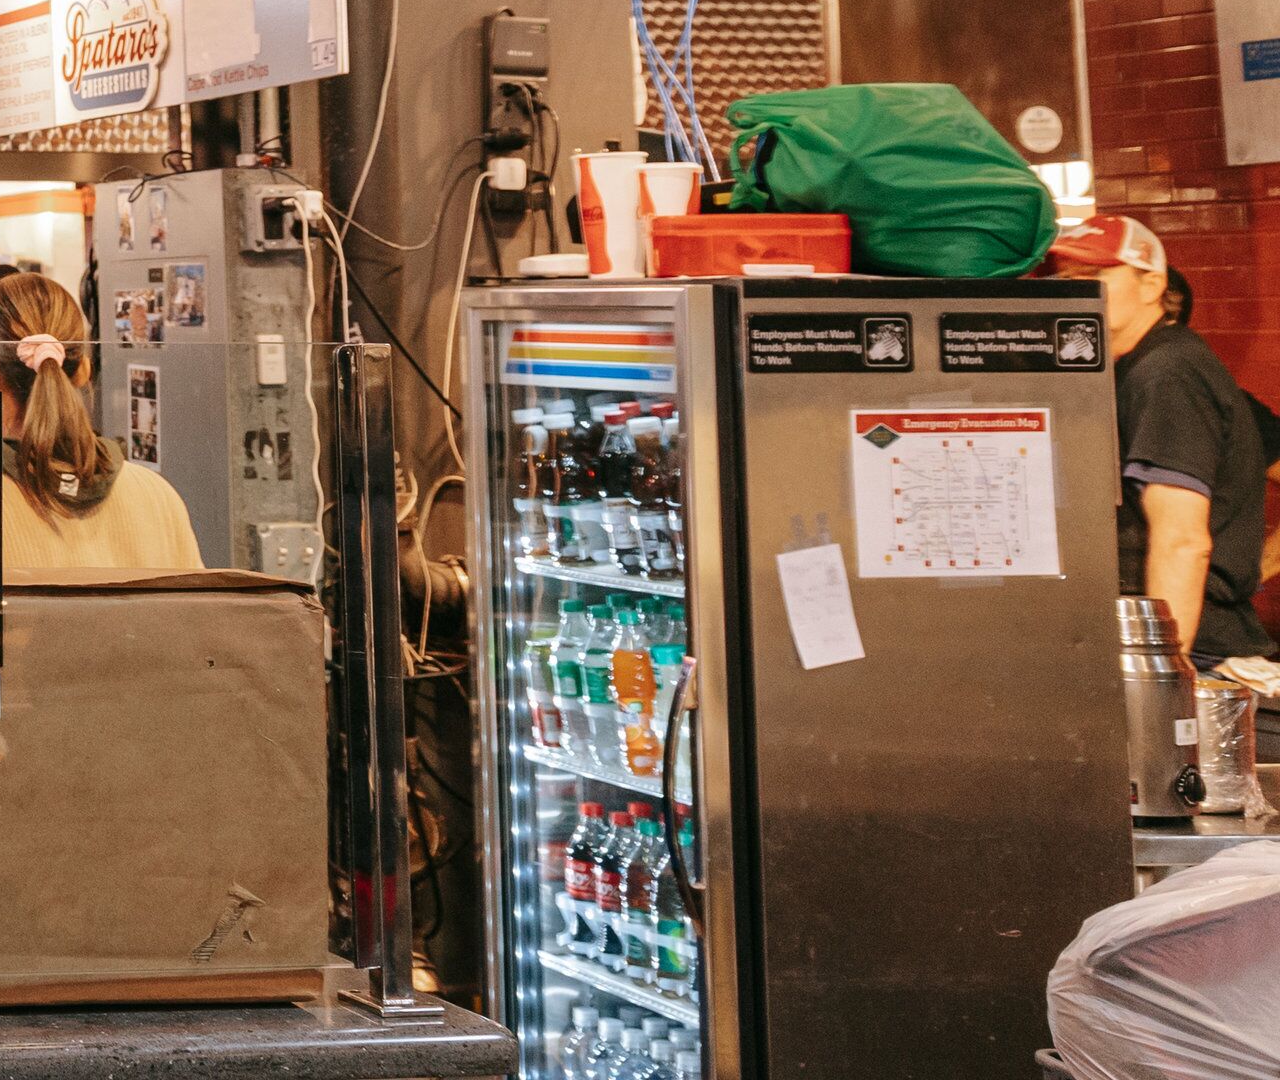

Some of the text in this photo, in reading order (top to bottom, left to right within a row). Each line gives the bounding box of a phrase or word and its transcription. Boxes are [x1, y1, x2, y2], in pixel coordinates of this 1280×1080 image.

[62, 8, 159, 93] Spataro's
[752, 330, 855, 341] Employees Must Wash
[944, 330, 1047, 341] Employees Must Wash
[754, 343, 863, 354] Hands Before Returning
[946, 343, 1054, 354] Hands Before Returning
[753, 356, 792, 365] To Work
[945, 356, 985, 365] To Work
[903, 418, 1040, 431] Emergency Evacuation Map
